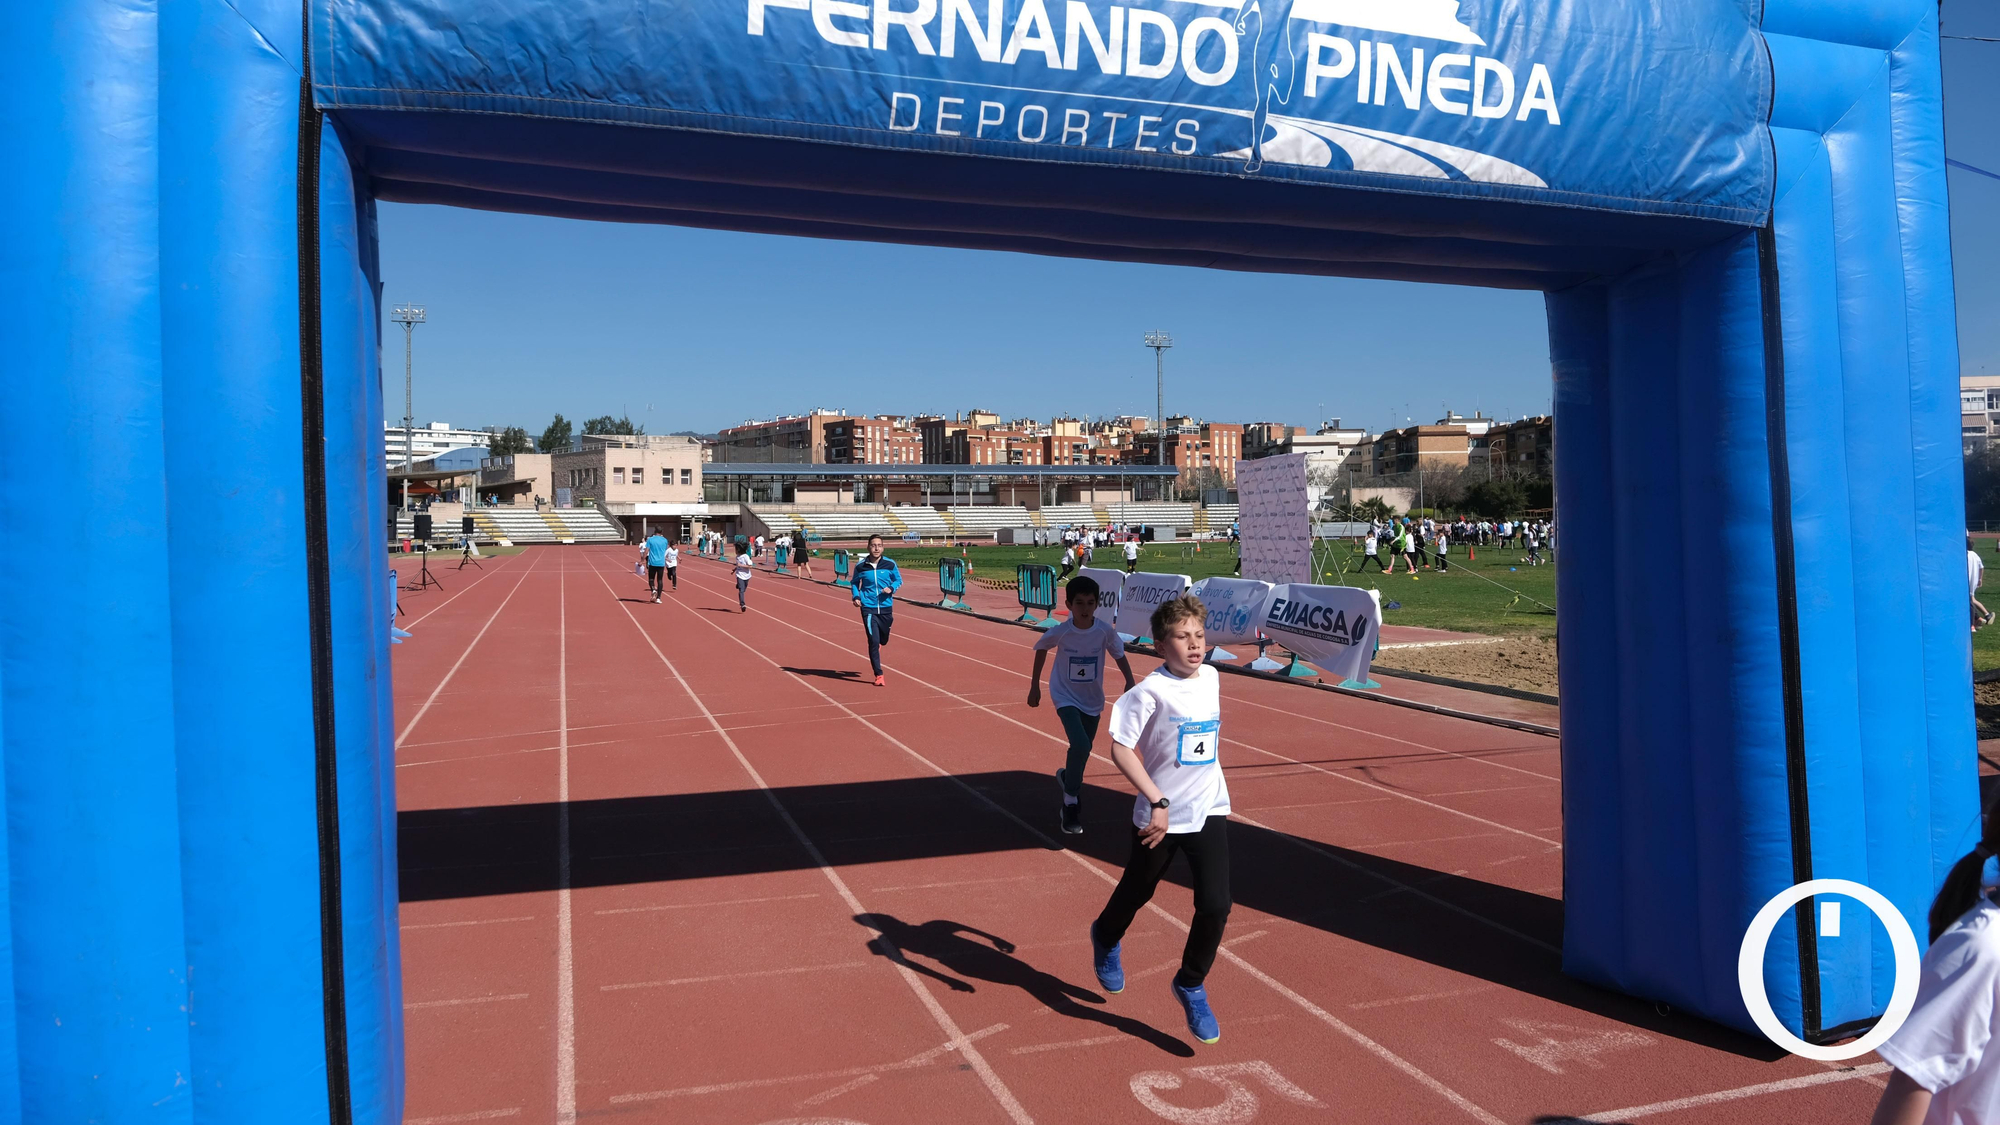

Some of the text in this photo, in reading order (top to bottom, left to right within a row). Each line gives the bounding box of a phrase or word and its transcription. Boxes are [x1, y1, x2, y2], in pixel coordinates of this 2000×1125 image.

[1304, 32, 1561, 126] PINEDA
[889, 91, 1200, 156] DEPORTES
[1099, 591, 1115, 608] eco
[1222, 587, 1234, 600] de
[1268, 598, 1349, 636] EMACSA
[1077, 668, 1085, 677] 4
[1193, 741, 1205, 755] 4
